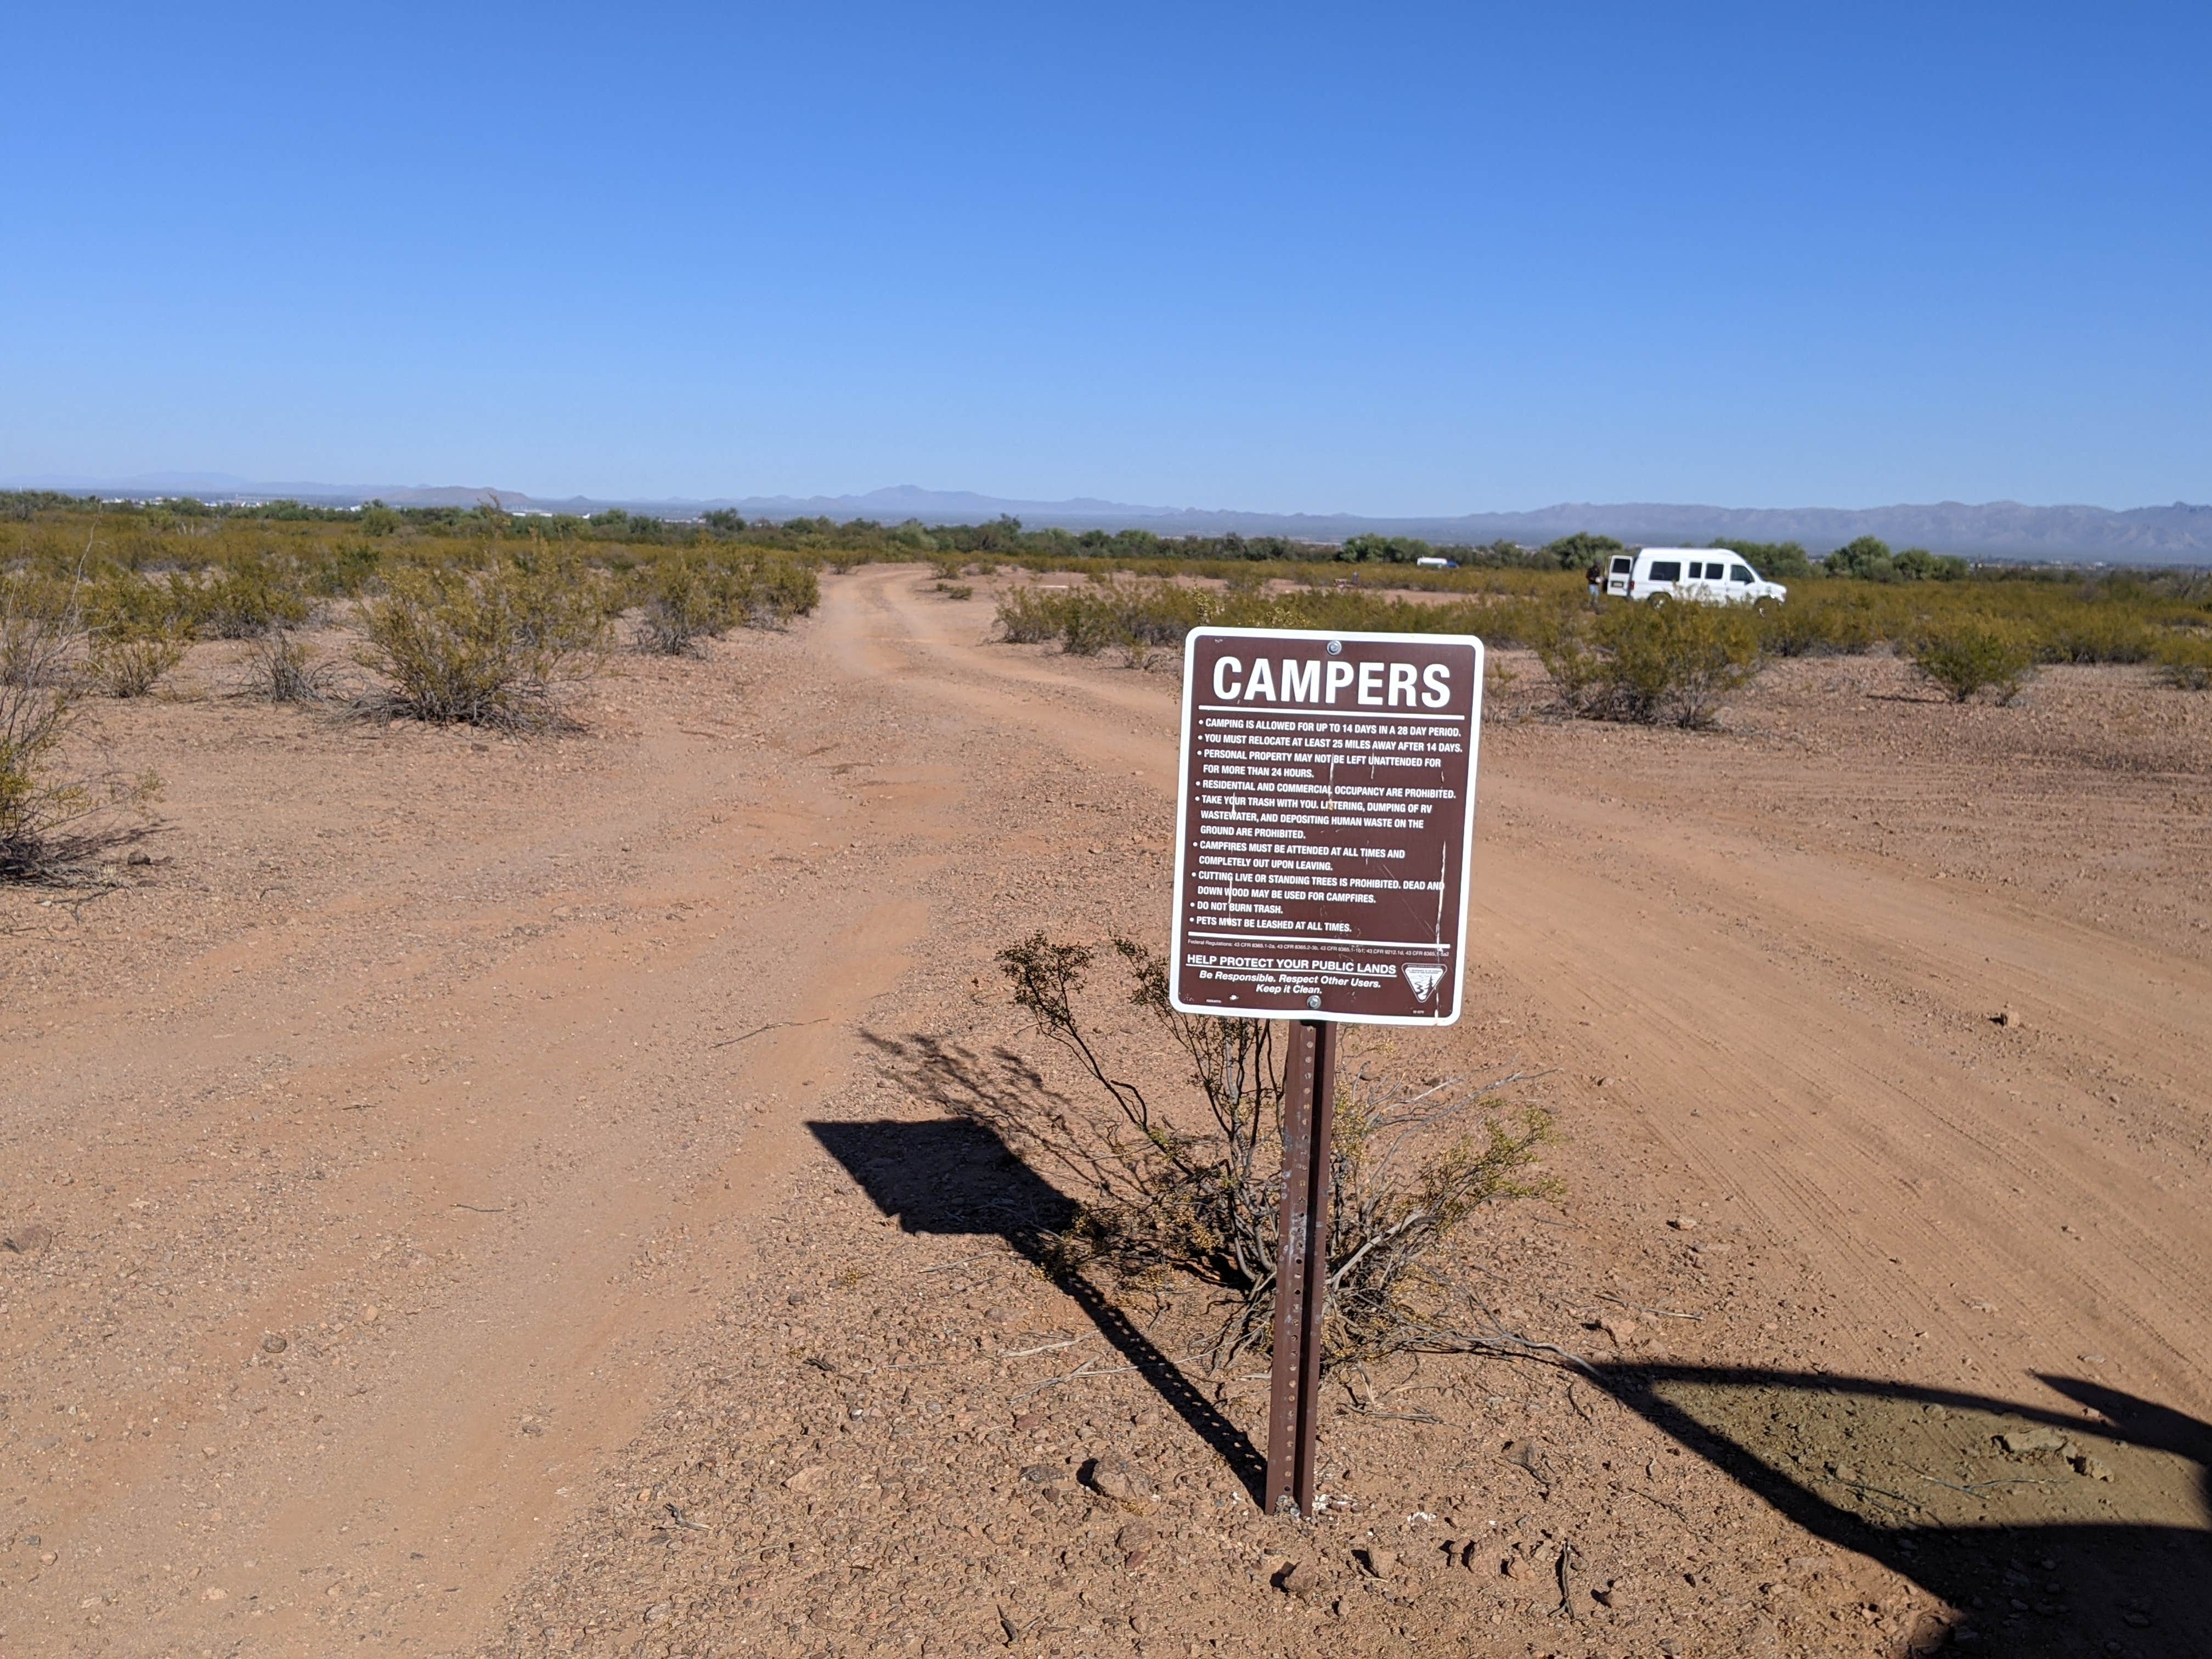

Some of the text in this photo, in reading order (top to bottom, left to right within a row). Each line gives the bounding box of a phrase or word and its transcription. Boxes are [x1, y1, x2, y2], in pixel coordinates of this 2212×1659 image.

[1214, 657, 1450, 707] CAMPERS
[1205, 718, 1461, 737] CAMPING IS ALLOWED FOR UP TO 14 DAYS IN A 28 DAY PERIOD.
[1204, 733, 1463, 753] YOU MUST RELOCATE AT LEAST 25 MILES AWAY AFTER 14 DAYS.
[1204, 749, 1441, 768] PERSONAL PROPERTY MAY NOT BE LEFT UNATTENDED FOR
[1203, 764, 1314, 778] FOR MORE THAN 24 HOURS.
[1203, 780, 1456, 799] RESIDENTIAL AND COMMERCIAL OCCUPANCY ARE PROHIBITED.
[1201, 794, 1222, 804] TAKE
[1223, 795, 1246, 806] YOUR
[1248, 797, 1275, 807] TRASH
[1277, 798, 1298, 808] WITH
[1300, 799, 1319, 809] YOU.
[1367, 802, 1406, 812] DUMPING
[1407, 804, 1419, 813] OF
[1420, 804, 1432, 814] RV
[1201, 810, 1424, 829] WASTEWATER, AND DEPOSITING HUMAN WASTE ON THE
[1200, 825, 1306, 839] GROUND ARE PROHIBITED.
[1200, 840, 1405, 859] CAMPFIRES MUST BE ATTENDED AT ALL TIMES AND
[1199, 855, 1333, 871] COMPLETELY OUT UPON LEAVING.
[1198, 871, 1445, 891] CUTTING LIVE OR STANDING TREES IS PROHIBITED. DEAD AND
[1198, 885, 1376, 903] DOWN WOOD MAY BE USED FOR CAMPFIRES.
[1197, 901, 1283, 914] DO NOT BURN TRASH.
[1196, 916, 1352, 932] PETS MUST BE LEASHED AT ALL TIMES.
[1187, 954, 1396, 973] HELP PROTECT YOUR PUBLIC LANDS
[1199, 970, 1381, 988] Be Responsible. Respect Other Users.
[1256, 984, 1322, 995] Keep it Clean.
